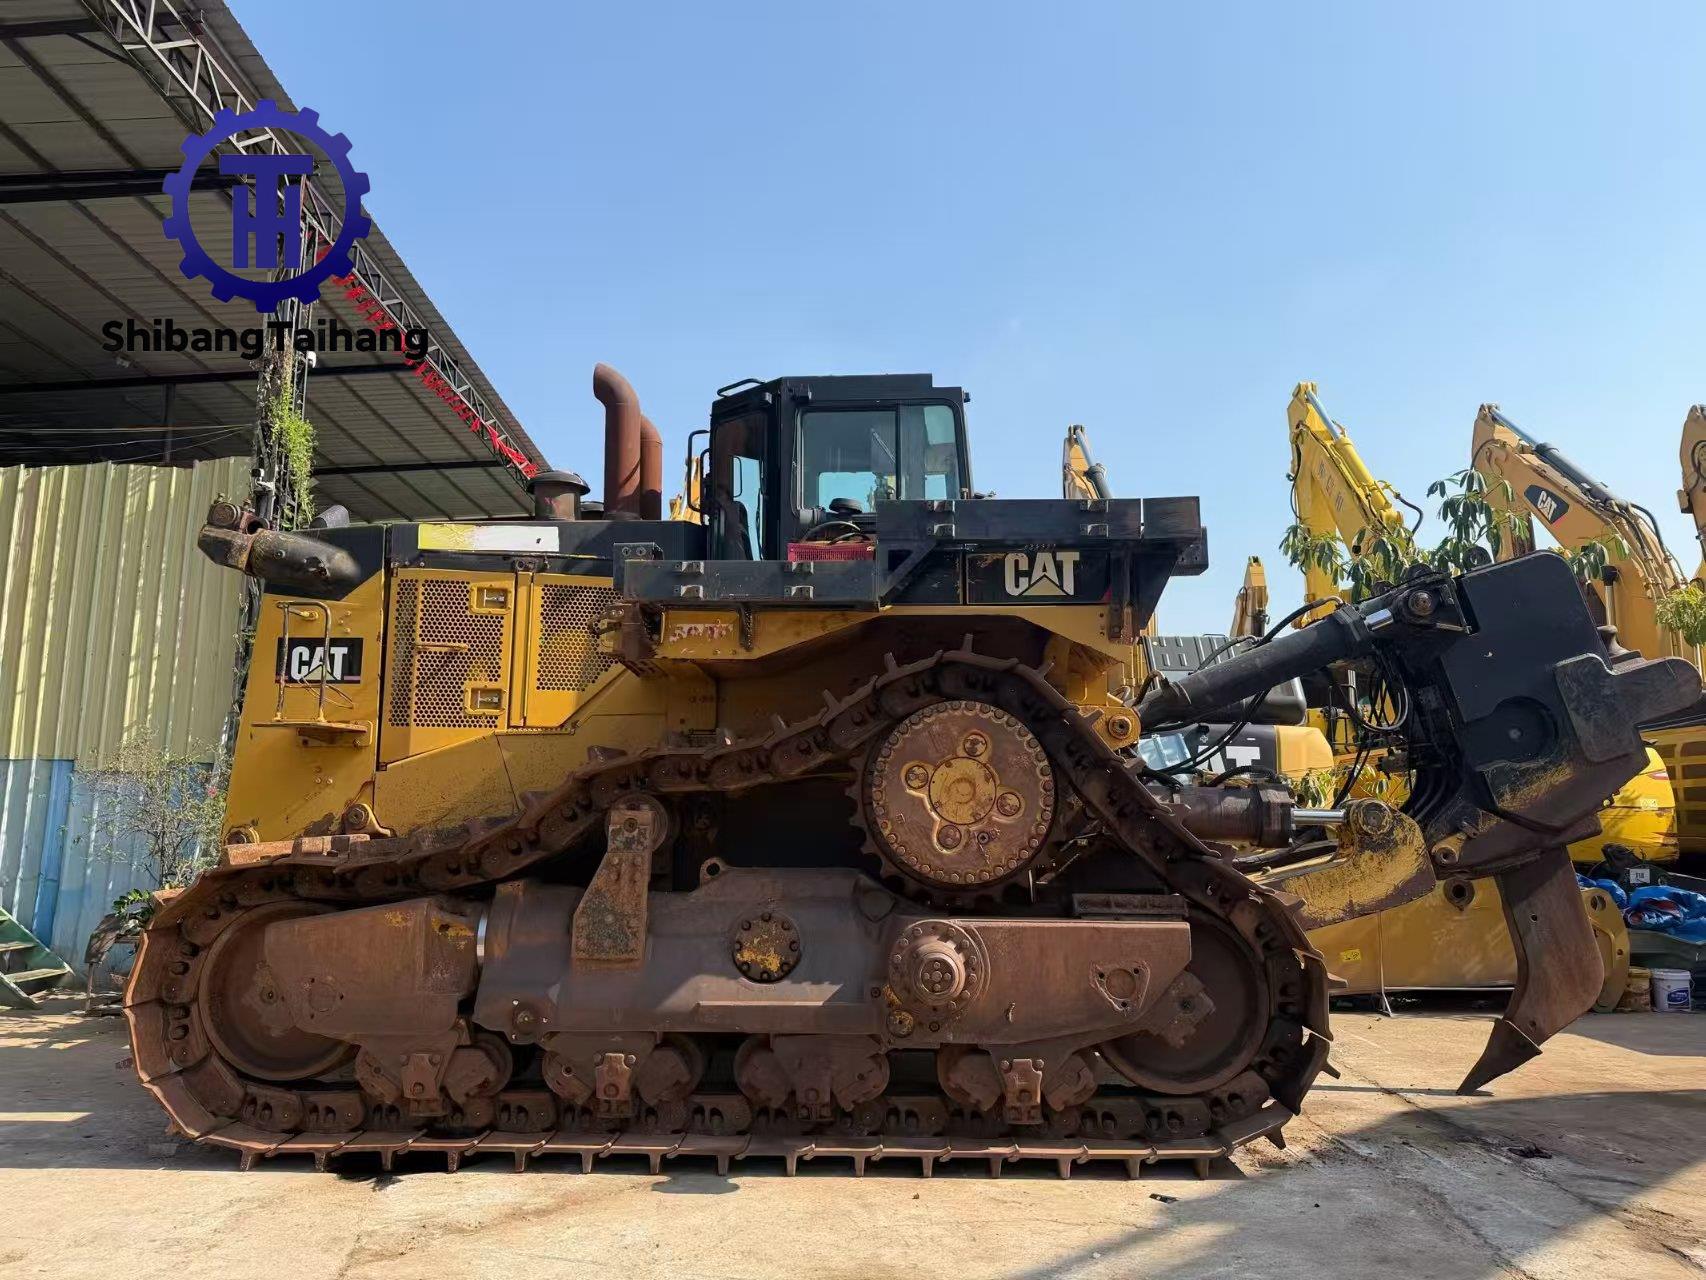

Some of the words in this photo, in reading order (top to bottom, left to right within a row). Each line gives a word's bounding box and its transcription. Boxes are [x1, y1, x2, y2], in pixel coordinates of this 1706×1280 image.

[1537, 490, 1557, 521] CAT
[1004, 551, 1080, 596] CAT
[290, 646, 348, 681] CAT
